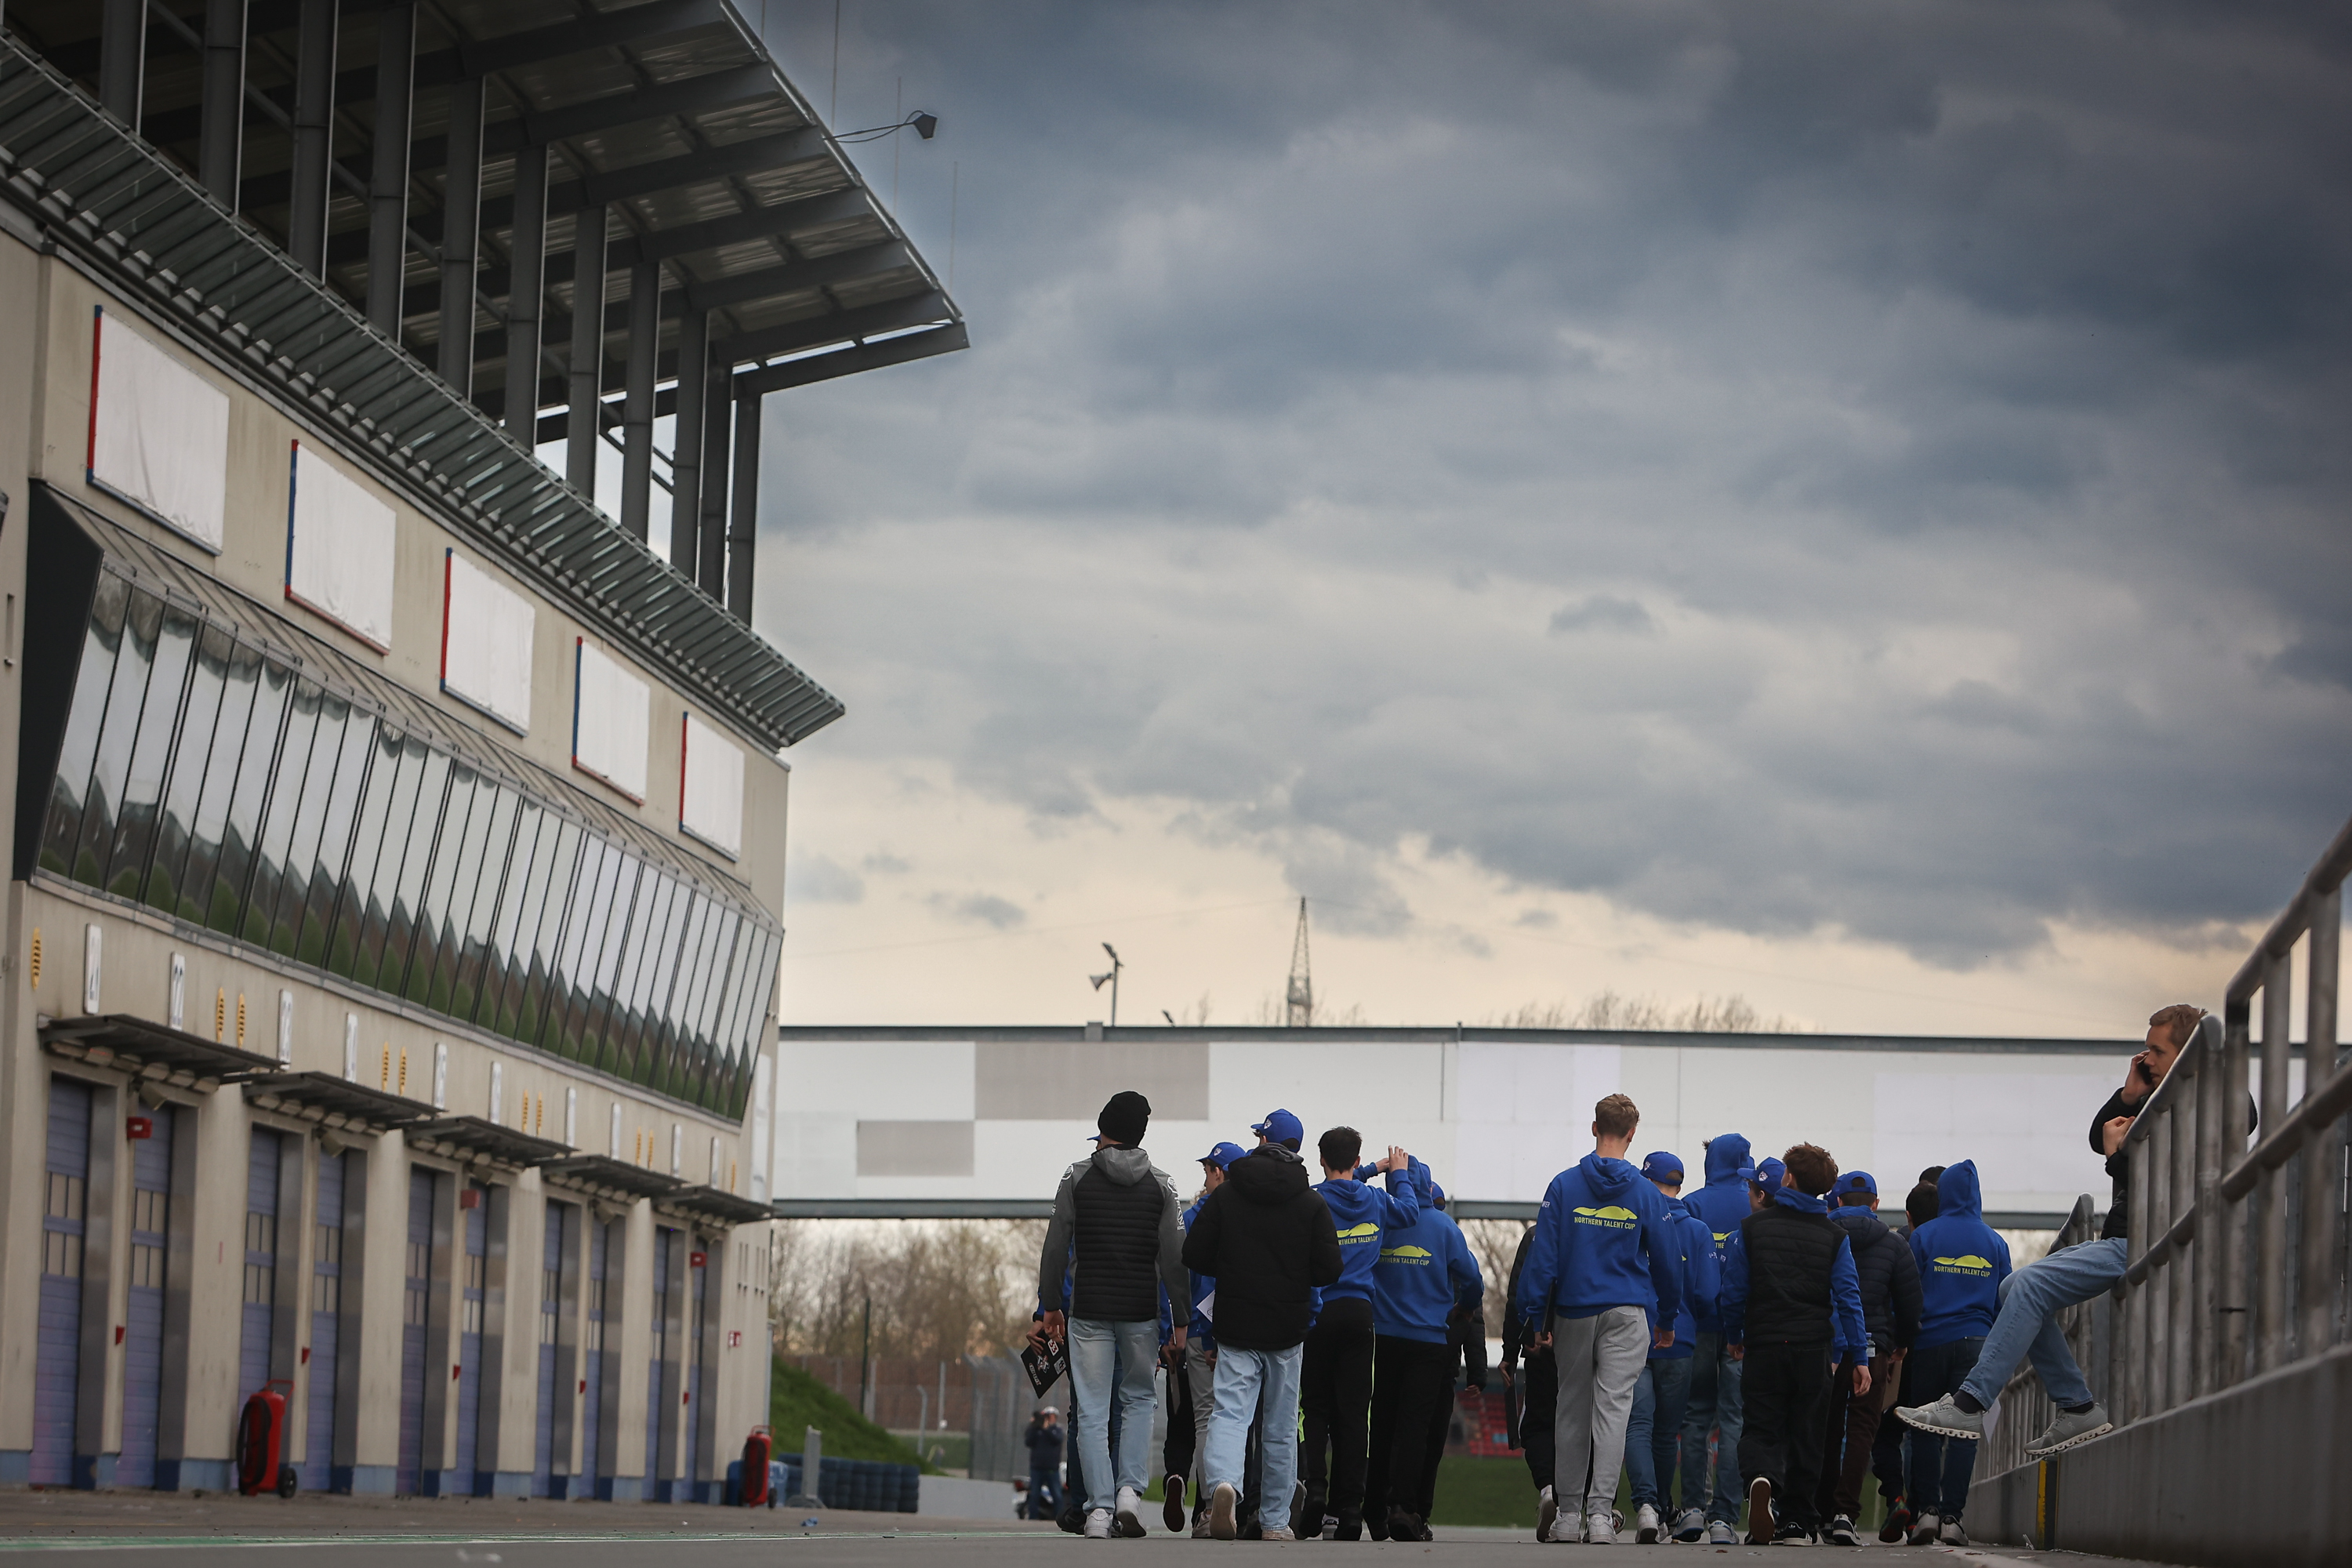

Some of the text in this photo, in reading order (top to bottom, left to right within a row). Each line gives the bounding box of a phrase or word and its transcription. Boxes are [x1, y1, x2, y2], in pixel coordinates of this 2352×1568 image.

[1573, 1216, 1603, 1226] NORTHERN
[1603, 1220, 1624, 1229] TALENT
[1338, 1237, 1357, 1246] RTHERN
[1933, 1265, 1961, 1274] NORTHERN
